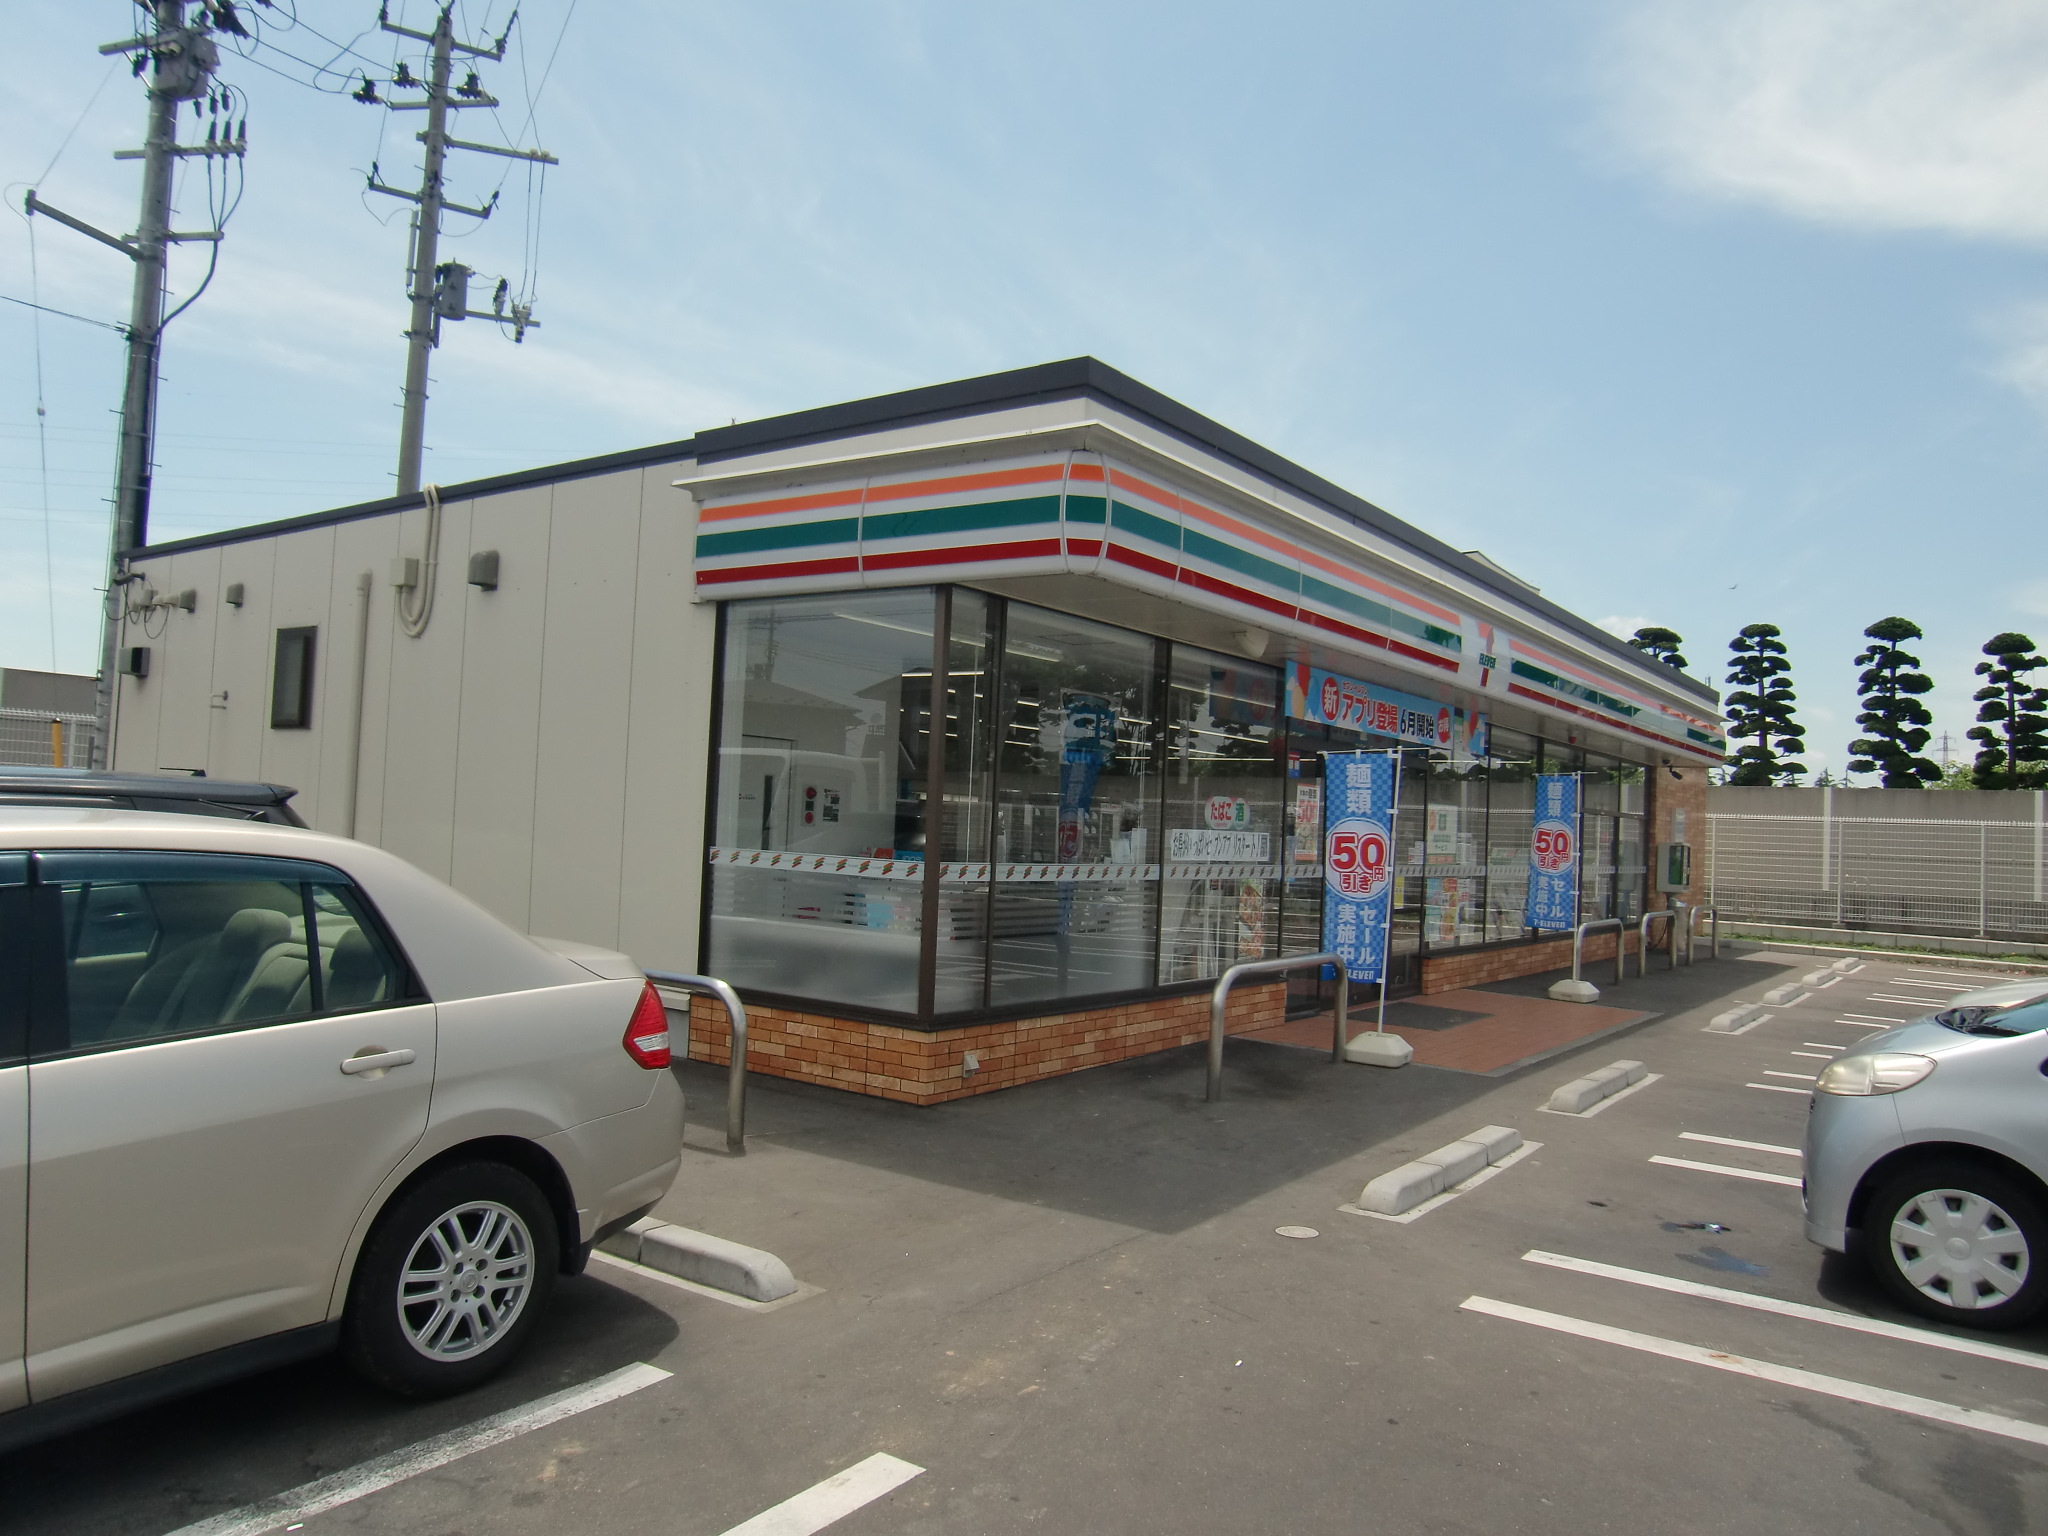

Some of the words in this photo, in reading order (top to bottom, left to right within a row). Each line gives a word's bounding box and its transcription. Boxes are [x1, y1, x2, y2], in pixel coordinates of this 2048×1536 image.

[1324, 684, 1337, 715] 新
[1341, 693, 1399, 734] アプリ登場
[1400, 708, 1435, 739] 6月開始
[1346, 763, 1372, 815] 麺類
[1210, 801, 1232, 821] たばこ
[1235, 802, 1245, 821] 酒
[1330, 832, 1386, 872] 50
[1534, 828, 1571, 856] 50
[1340, 873, 1373, 893] 引き
[1536, 876, 1549, 917] 実施中
[1551, 877, 1565, 918] セール
[1337, 904, 1357, 963] 実施中
[1357, 905, 1376, 964] セール
